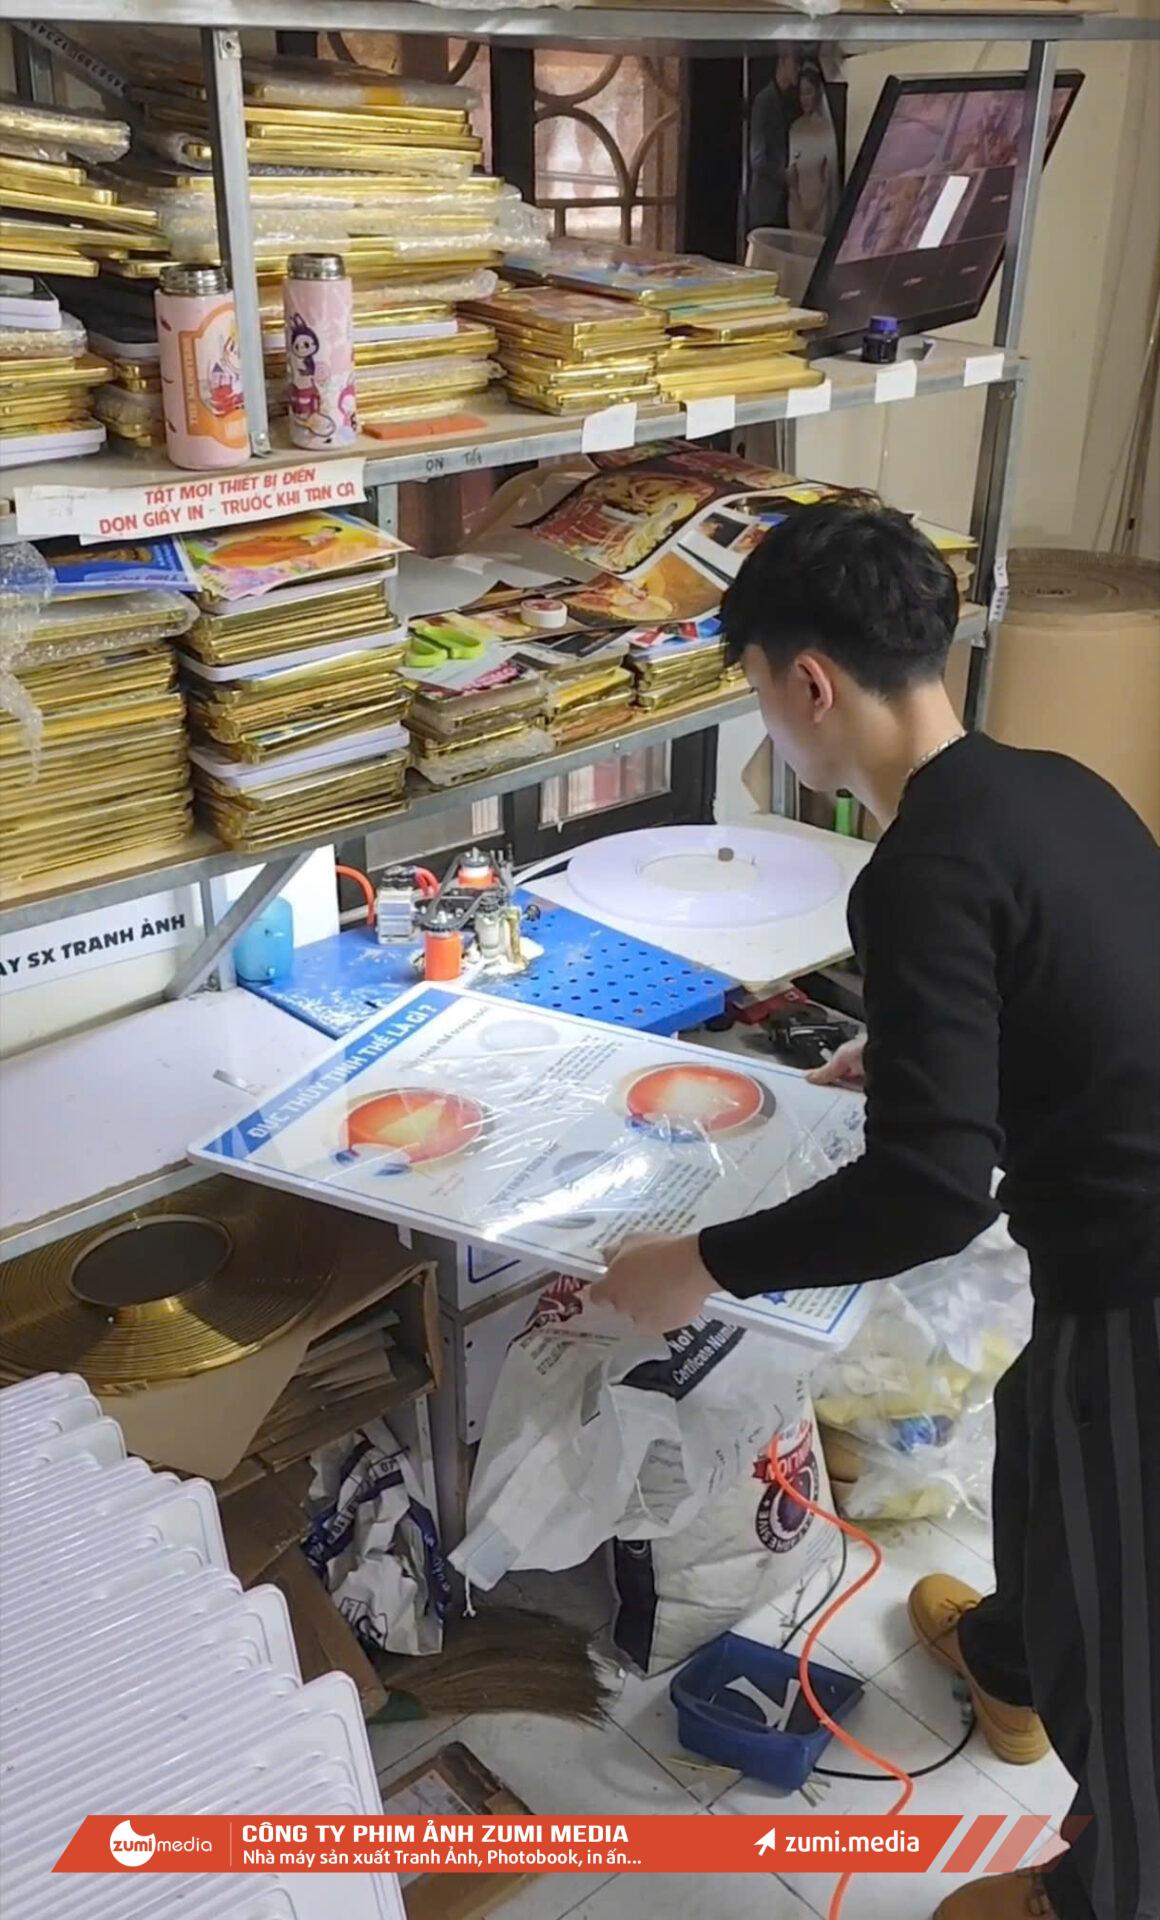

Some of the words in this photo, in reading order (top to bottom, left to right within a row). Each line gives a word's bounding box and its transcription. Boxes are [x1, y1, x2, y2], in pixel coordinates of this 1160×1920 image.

[187, 505, 204, 520] IN
[276, 490, 300, 506] KHI
[305, 485, 332, 502] TAN
[337, 482, 355, 497] CA
[27, 948, 55, 969] SX
[60, 927, 134, 958] TRANH
[141, 914, 186, 939] ẢNH
